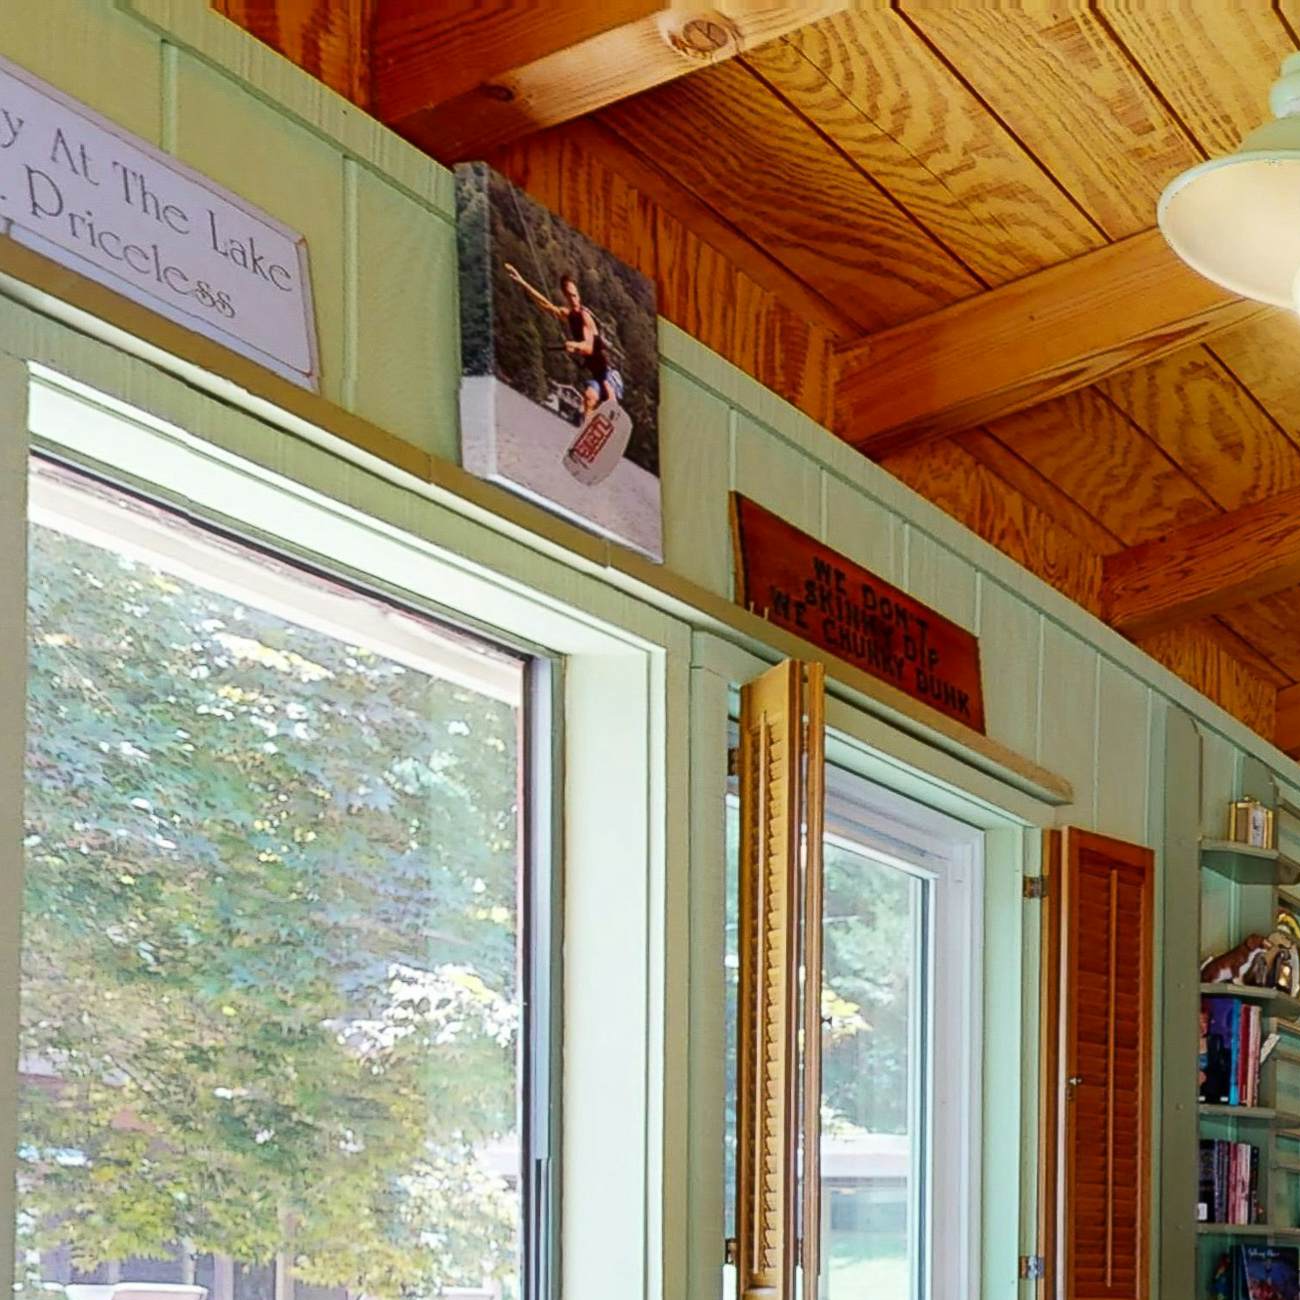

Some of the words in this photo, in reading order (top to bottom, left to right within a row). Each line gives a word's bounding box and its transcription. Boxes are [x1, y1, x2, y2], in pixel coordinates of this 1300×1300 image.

[51, 127, 99, 185] At
[112, 161, 190, 234] The
[208, 210, 292, 291] Lake
[813, 557, 848, 596] WE
[822, 618, 905, 680] CHUNKY
[915, 667, 970, 717] DUNK
